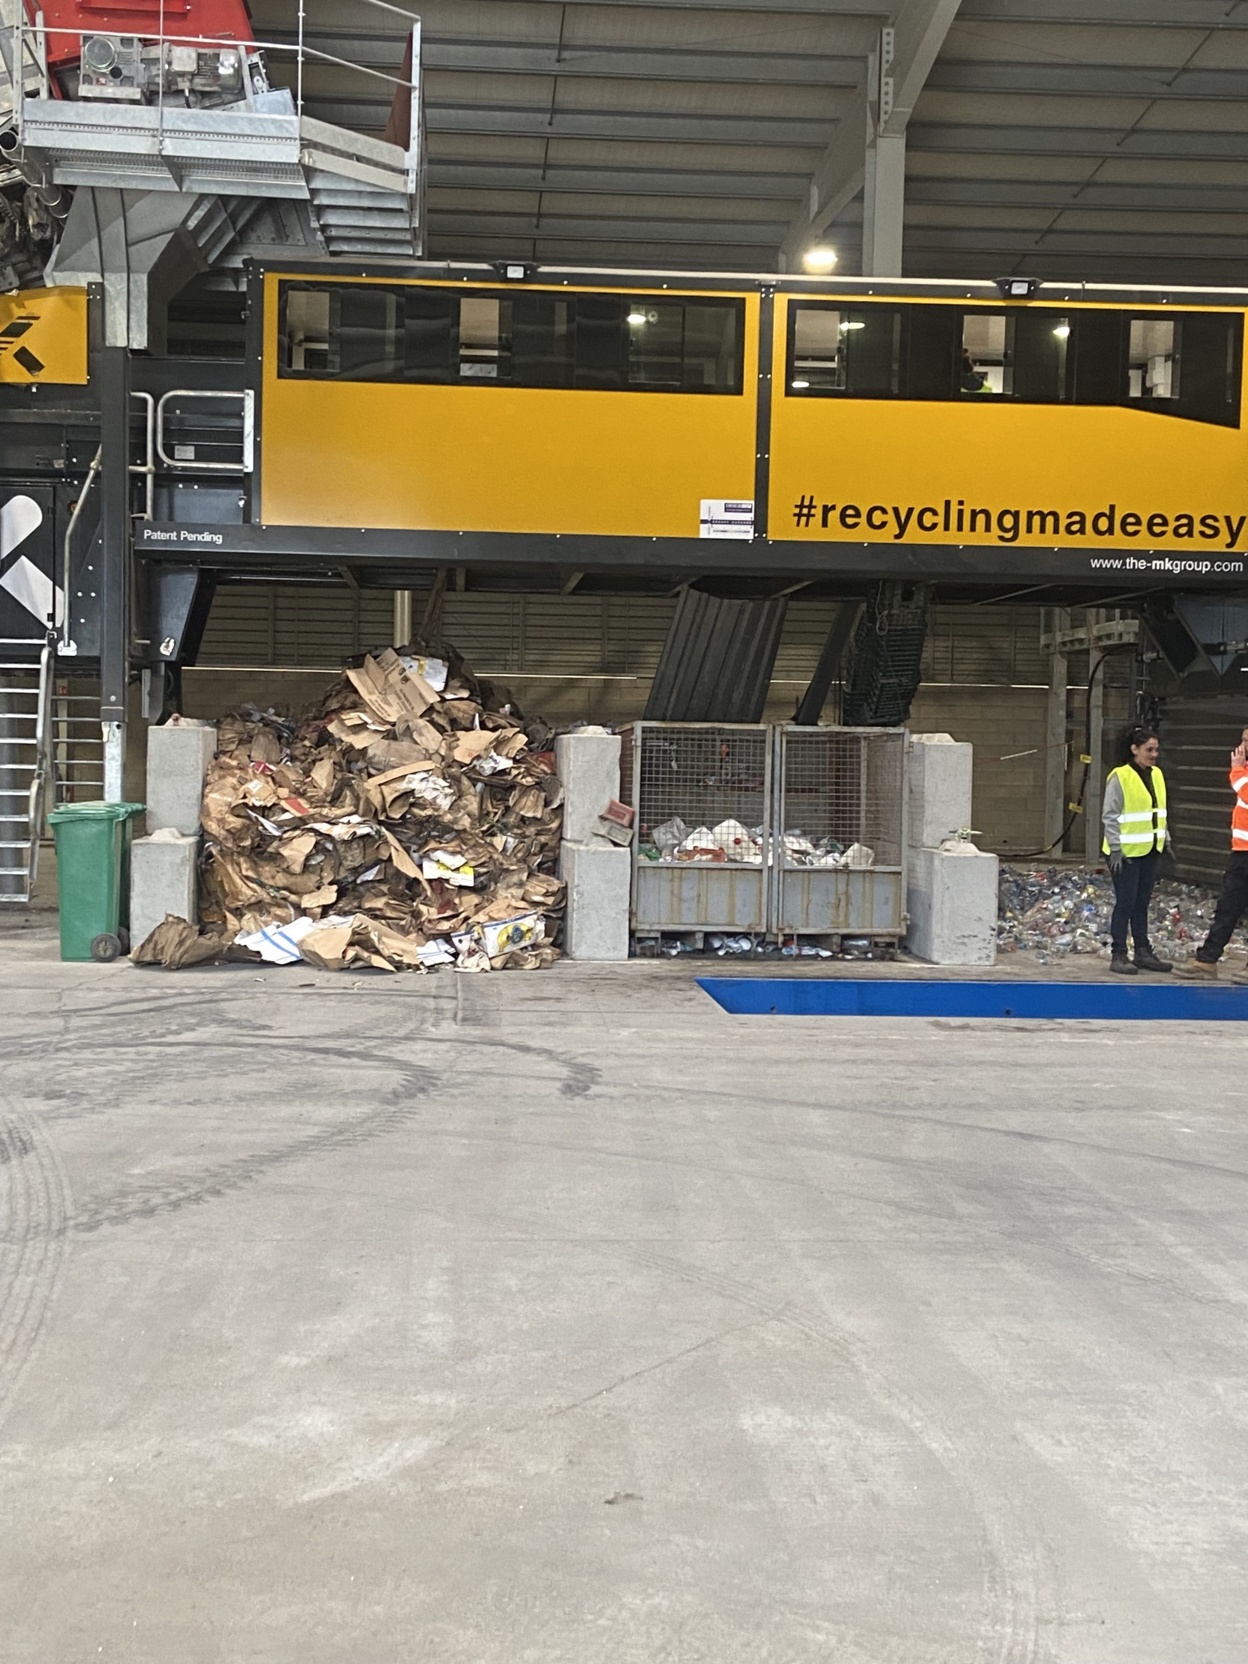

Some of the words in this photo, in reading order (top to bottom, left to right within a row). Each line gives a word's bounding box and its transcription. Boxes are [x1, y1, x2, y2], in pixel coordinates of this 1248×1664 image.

[793, 495, 1247, 549] #recyclingmadeeasy
[143, 529, 178, 541] Patent
[180, 530, 223, 545] Pending
[1090, 556, 1244, 574] www.the-mkgroup.com
